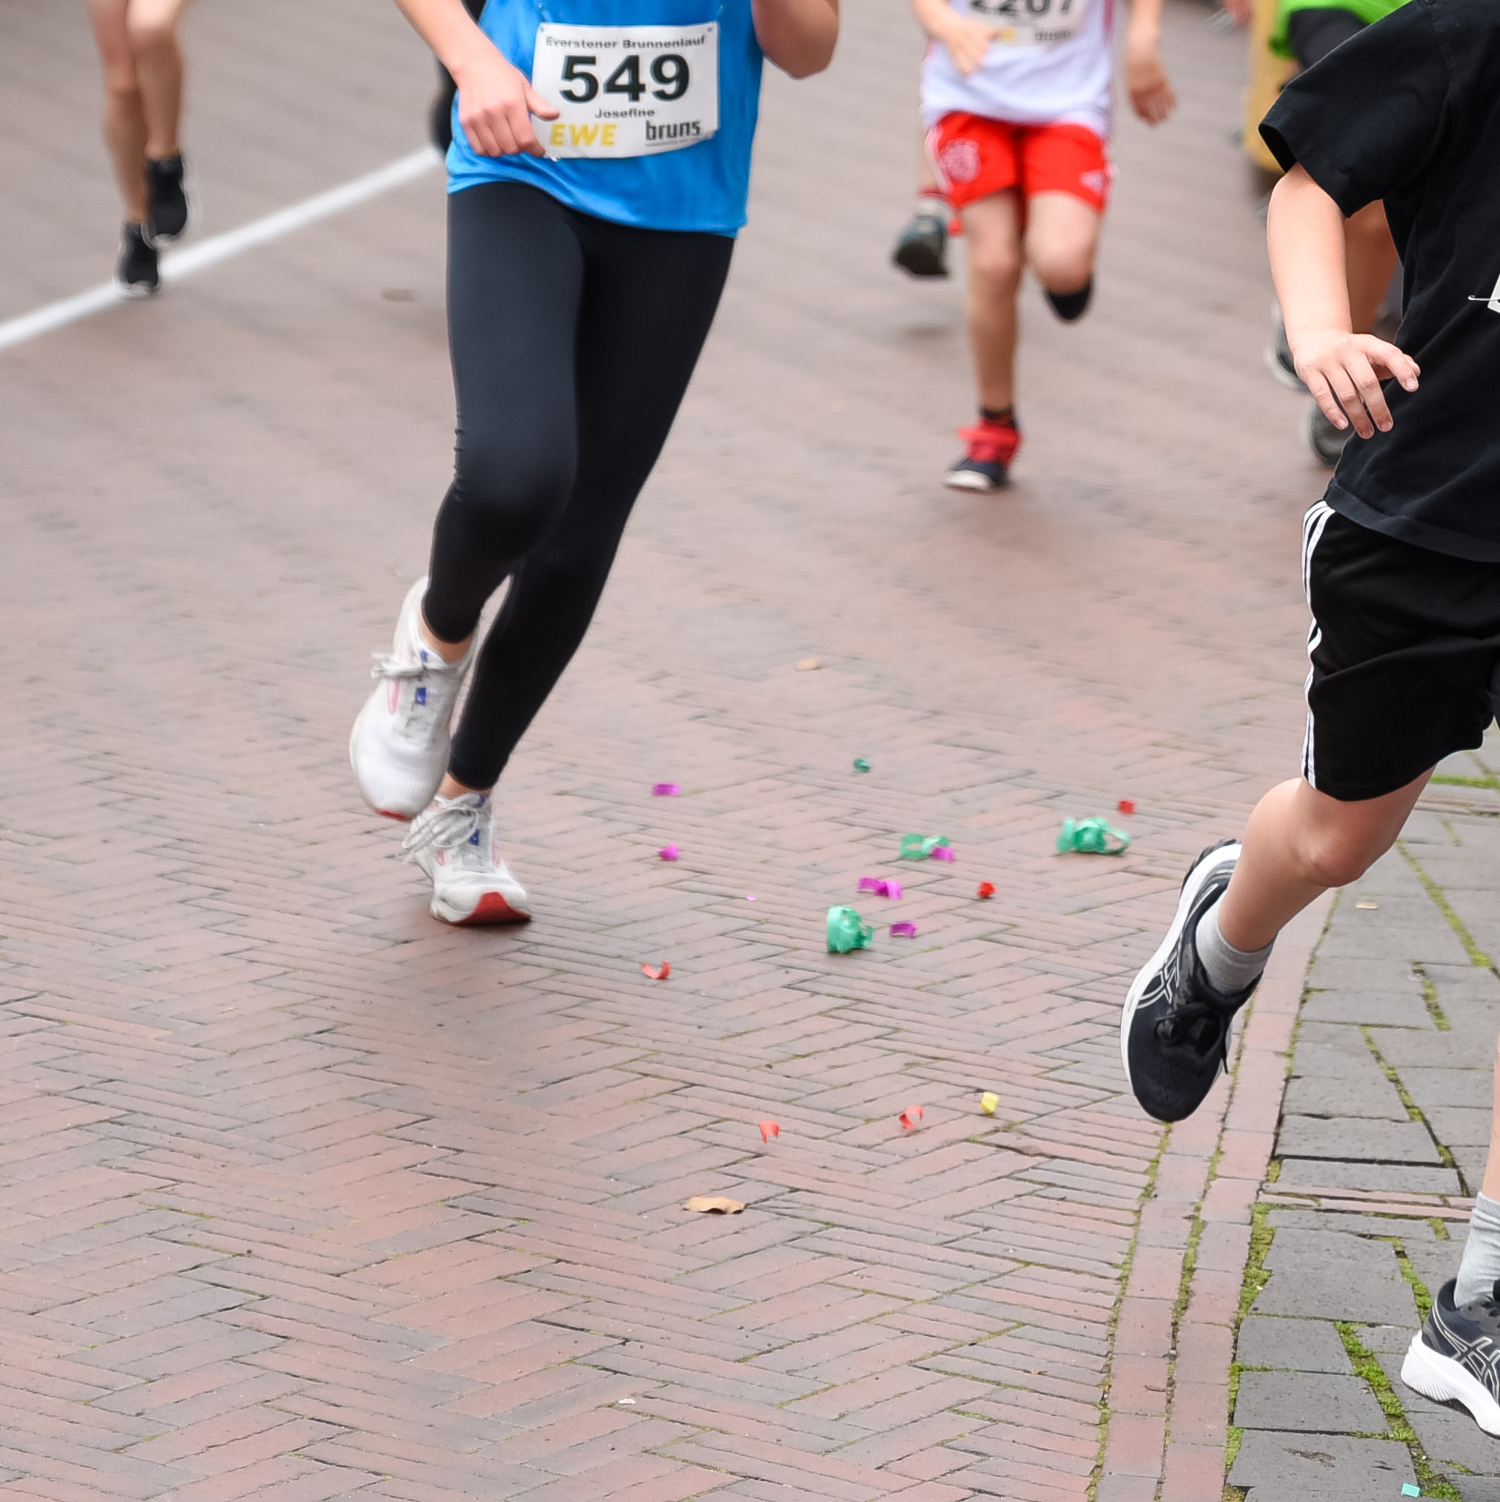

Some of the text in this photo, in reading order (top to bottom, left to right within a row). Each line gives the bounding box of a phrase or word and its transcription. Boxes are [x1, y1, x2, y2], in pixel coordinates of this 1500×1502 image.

[546, 35, 706, 49] Everstener Brunnenlauf
[559, 53, 690, 104] 549
[594, 108, 656, 119] Josefine
[550, 123, 617, 146] EWE
[645, 120, 701, 141] bruns
